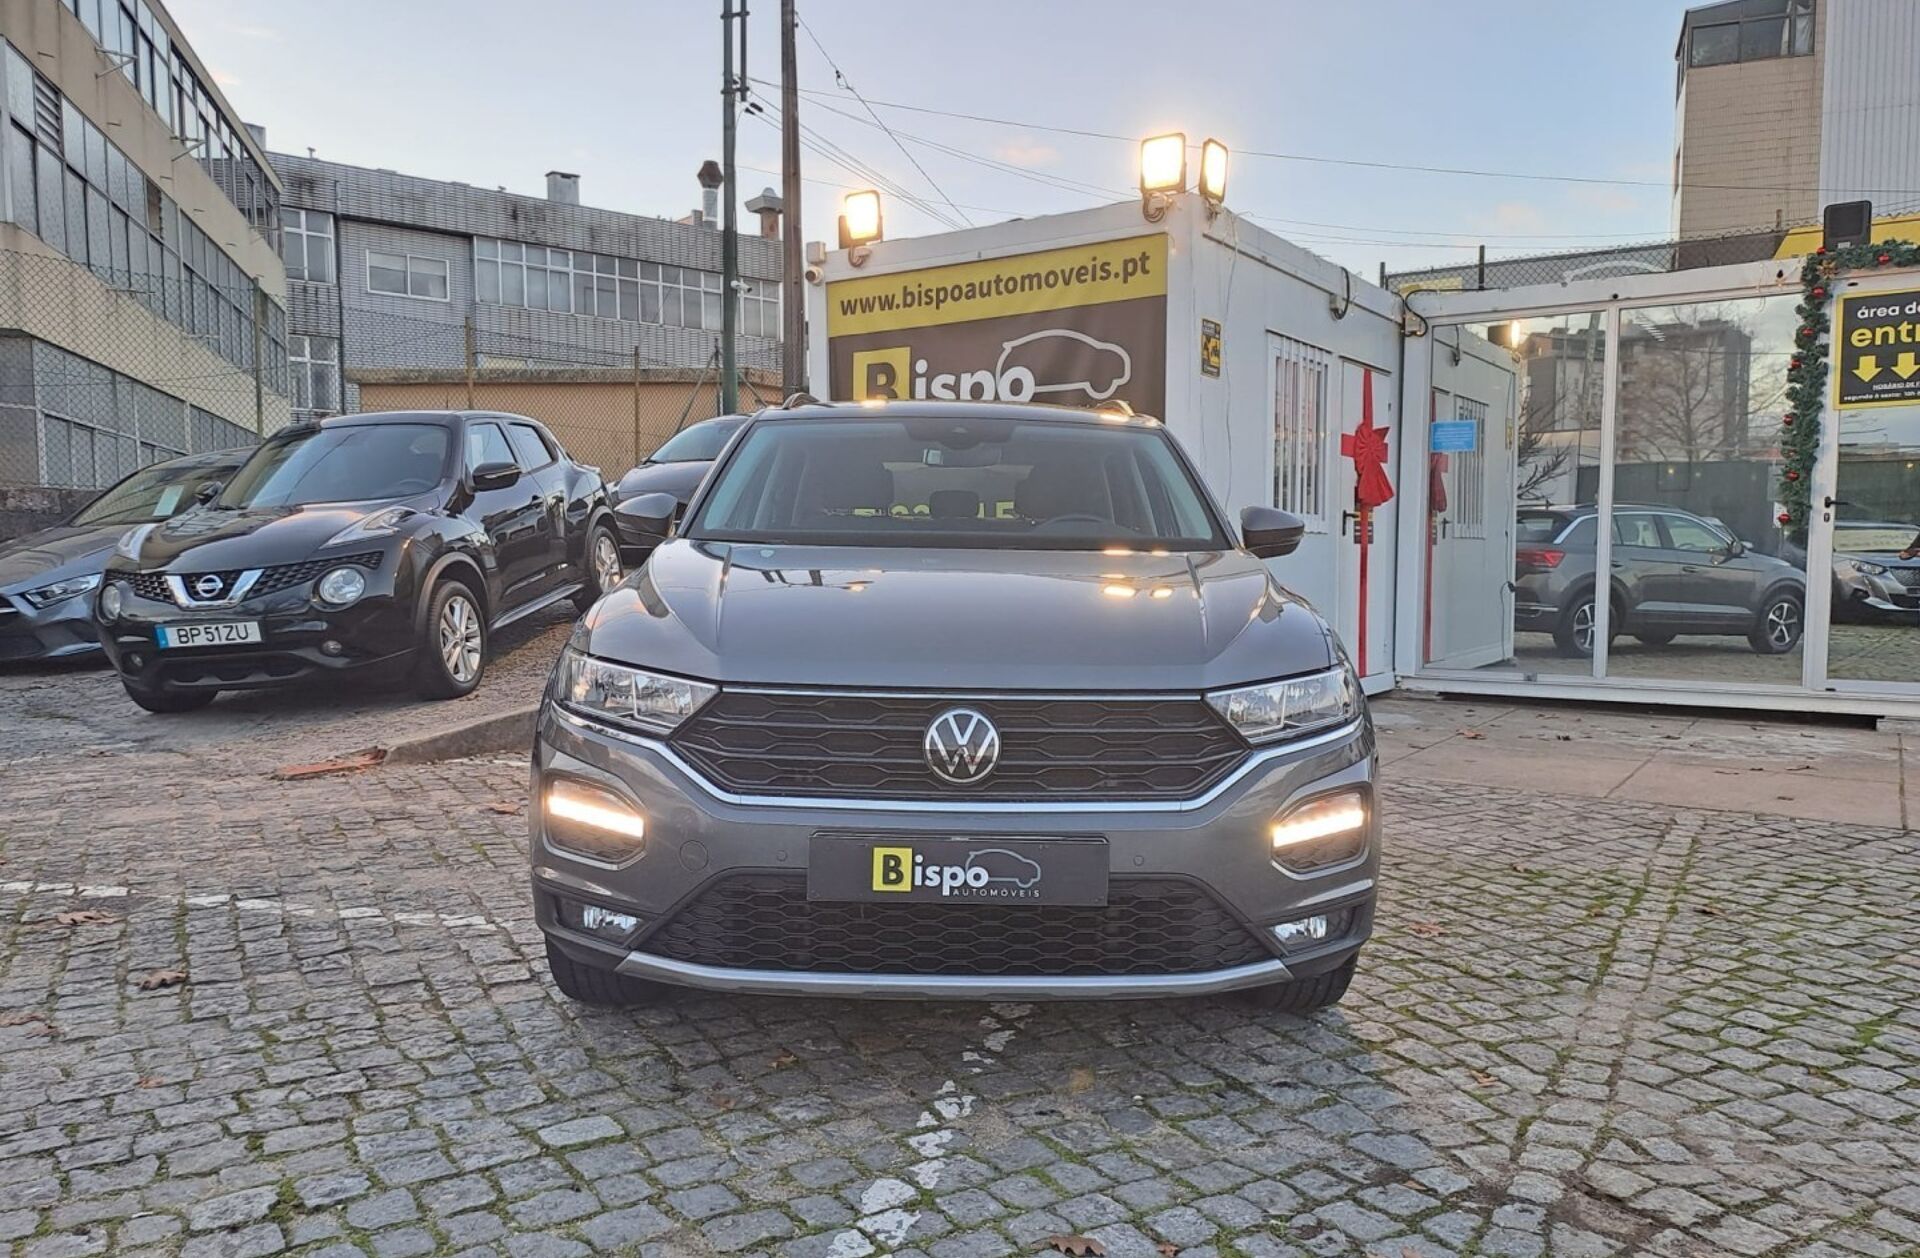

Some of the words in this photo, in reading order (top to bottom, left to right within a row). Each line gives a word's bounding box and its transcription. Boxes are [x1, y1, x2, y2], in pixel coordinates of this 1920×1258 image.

[840, 250, 1150, 316] www.bispoautomoveis.pt
[1857, 306, 1900, 318] área
[881, 853, 989, 896] Bispo
[953, 887, 1041, 898] AUTOMÓVEIS
